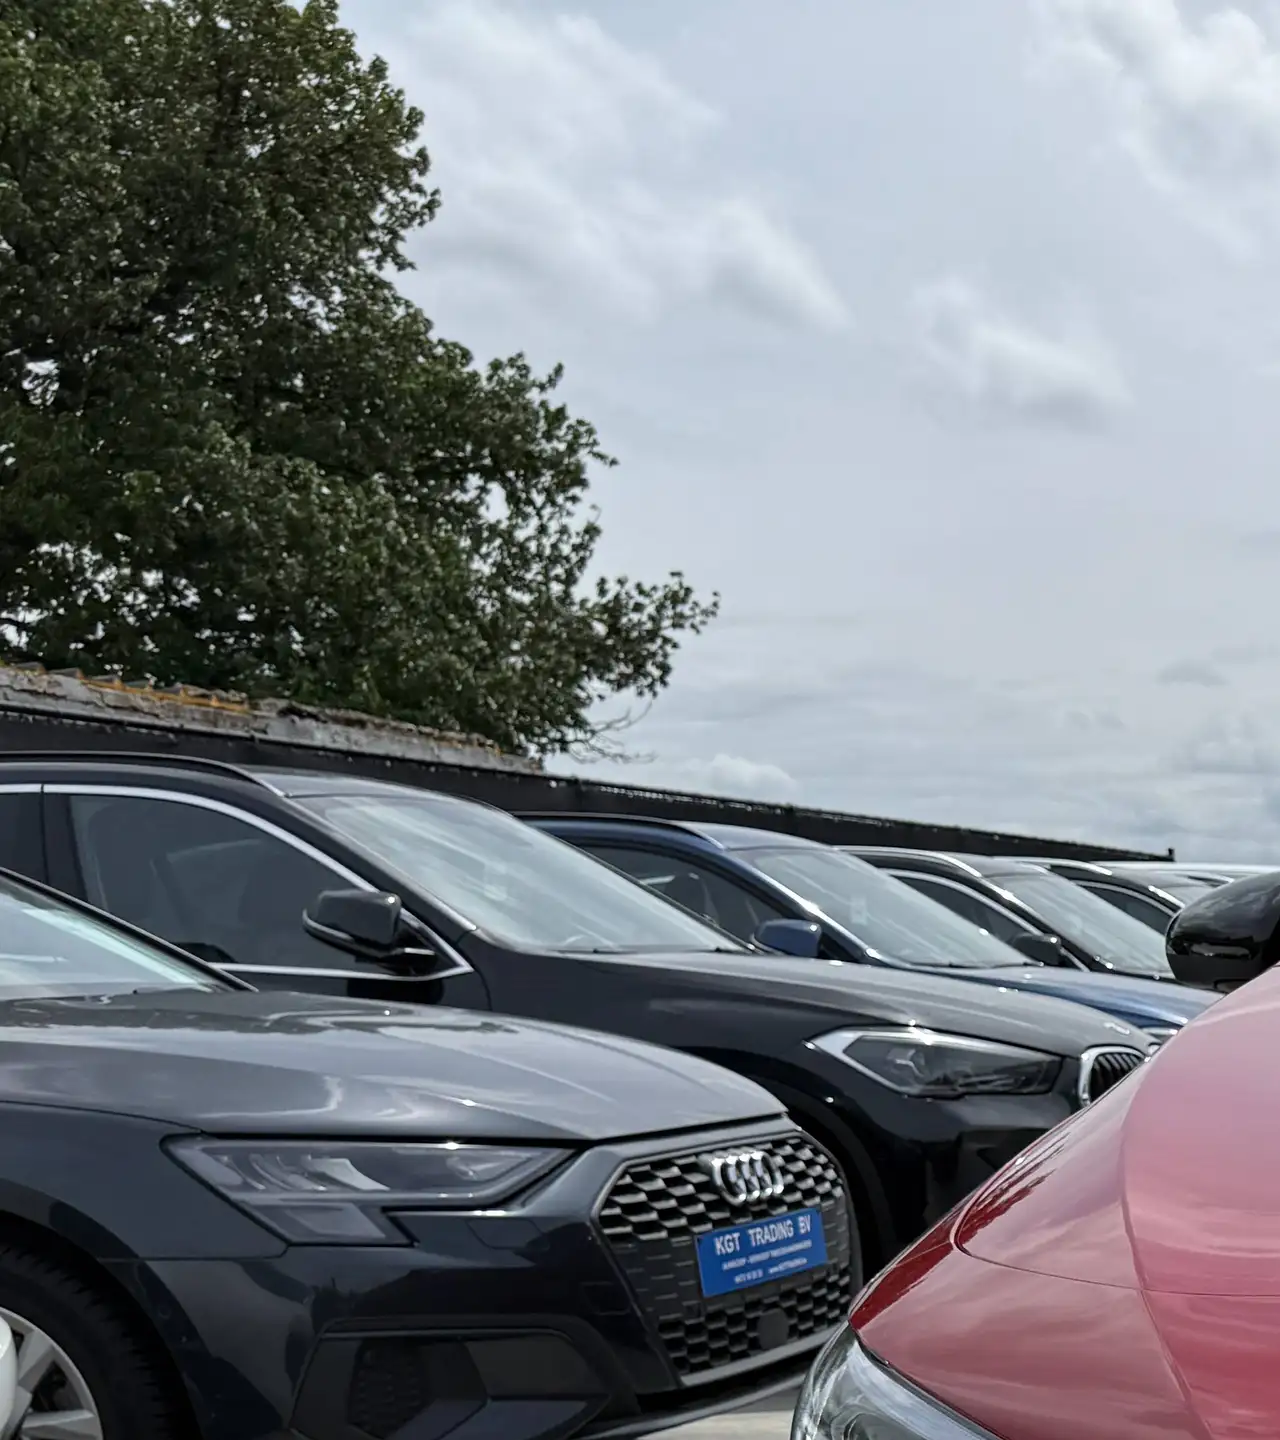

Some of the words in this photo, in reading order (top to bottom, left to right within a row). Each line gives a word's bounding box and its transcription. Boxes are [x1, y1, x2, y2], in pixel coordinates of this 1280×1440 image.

[715, 1233, 740, 1255] KGT
[748, 1220, 793, 1246] TRADING
[798, 1215, 811, 1233] BV
